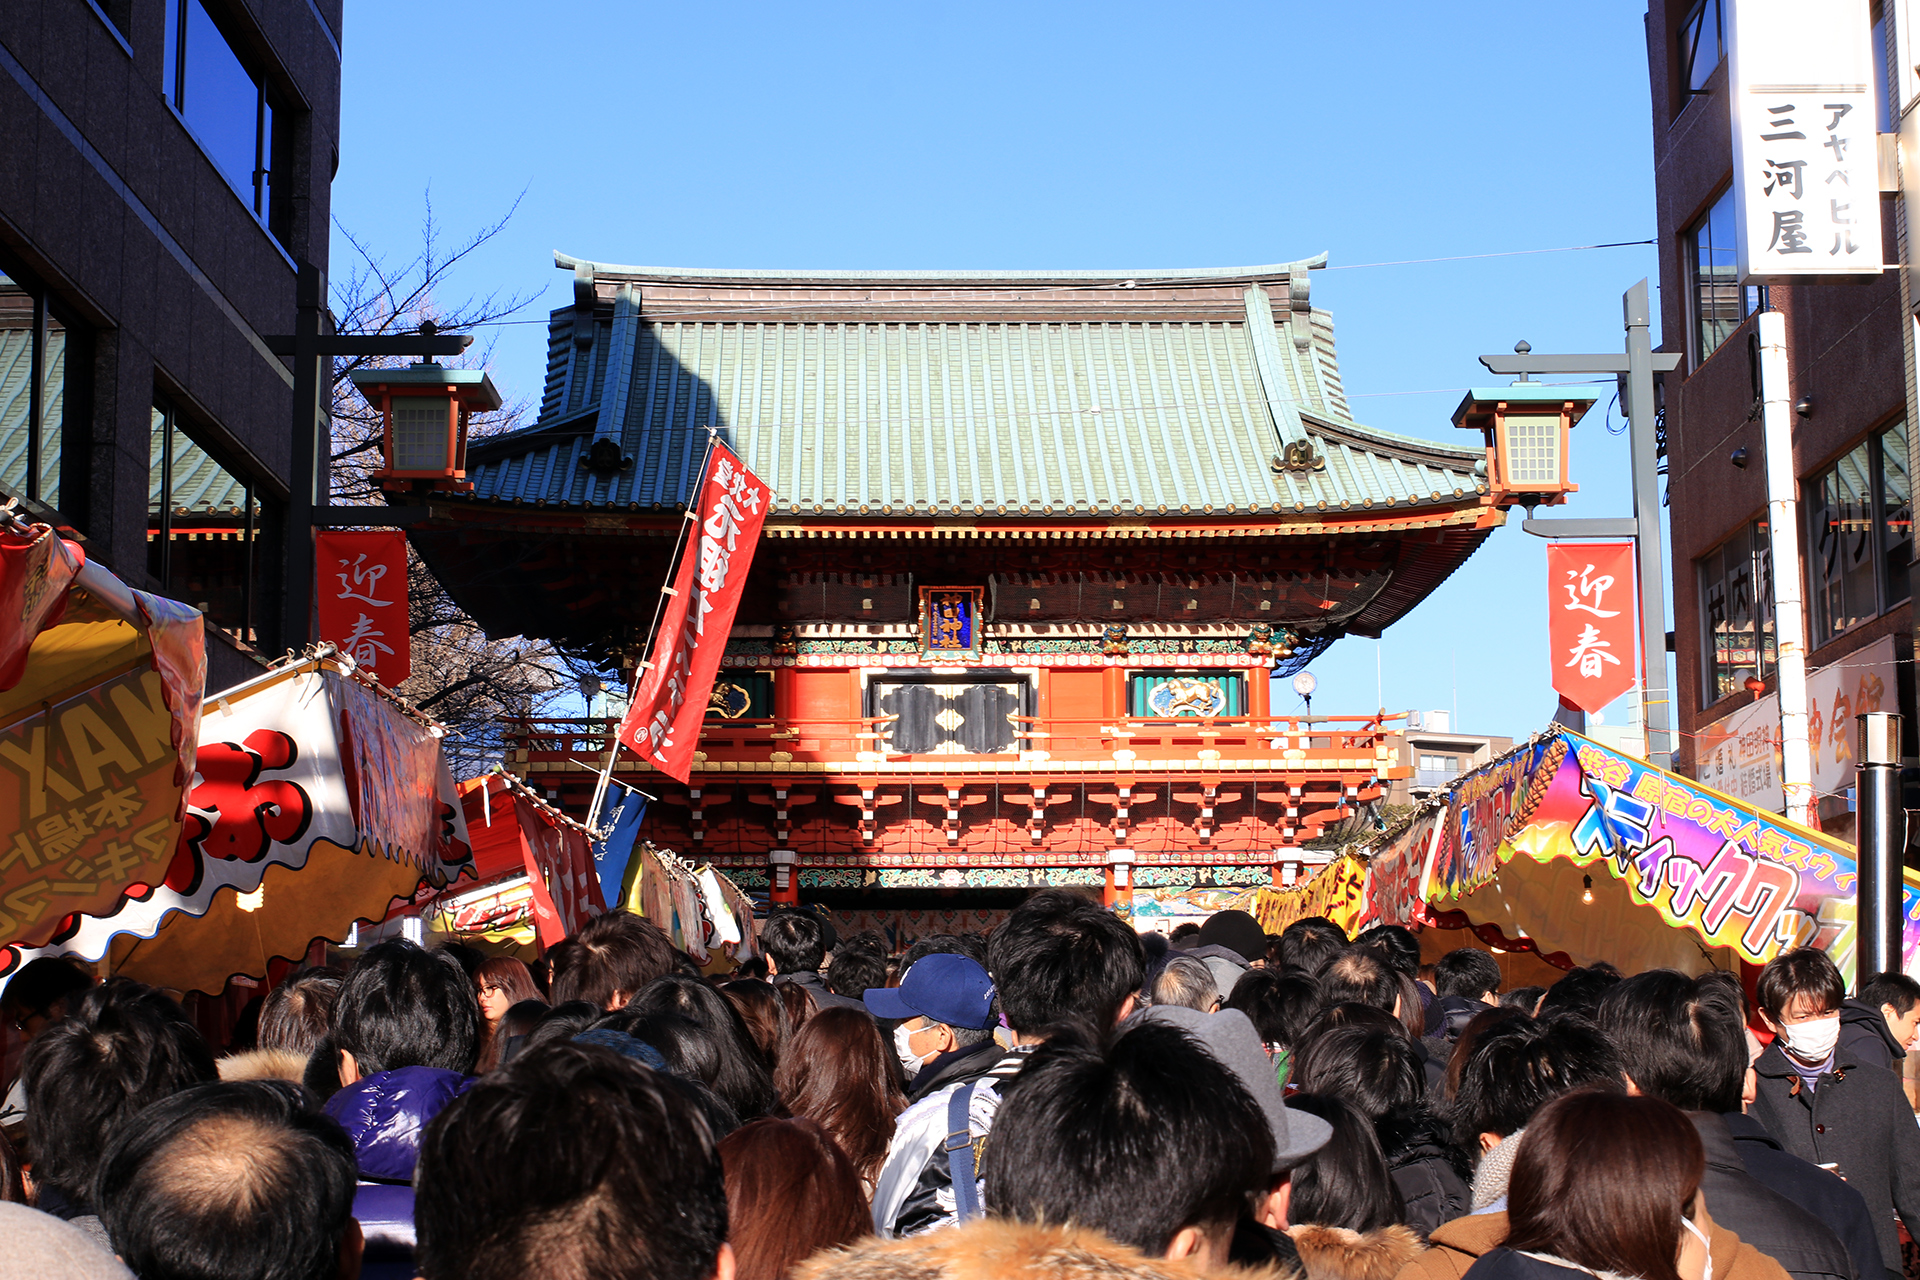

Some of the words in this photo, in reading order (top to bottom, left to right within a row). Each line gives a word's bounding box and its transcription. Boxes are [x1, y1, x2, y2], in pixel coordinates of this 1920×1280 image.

[1760, 104, 1813, 256] 三河屋
[336, 553, 395, 668] 迎春
[1563, 563, 1621, 679] 迎春
[1577, 744, 1632, 790] 渋谷
[1740, 761, 1772, 798] 結婚式場
[1571, 776, 1857, 995] スティックワッフ
